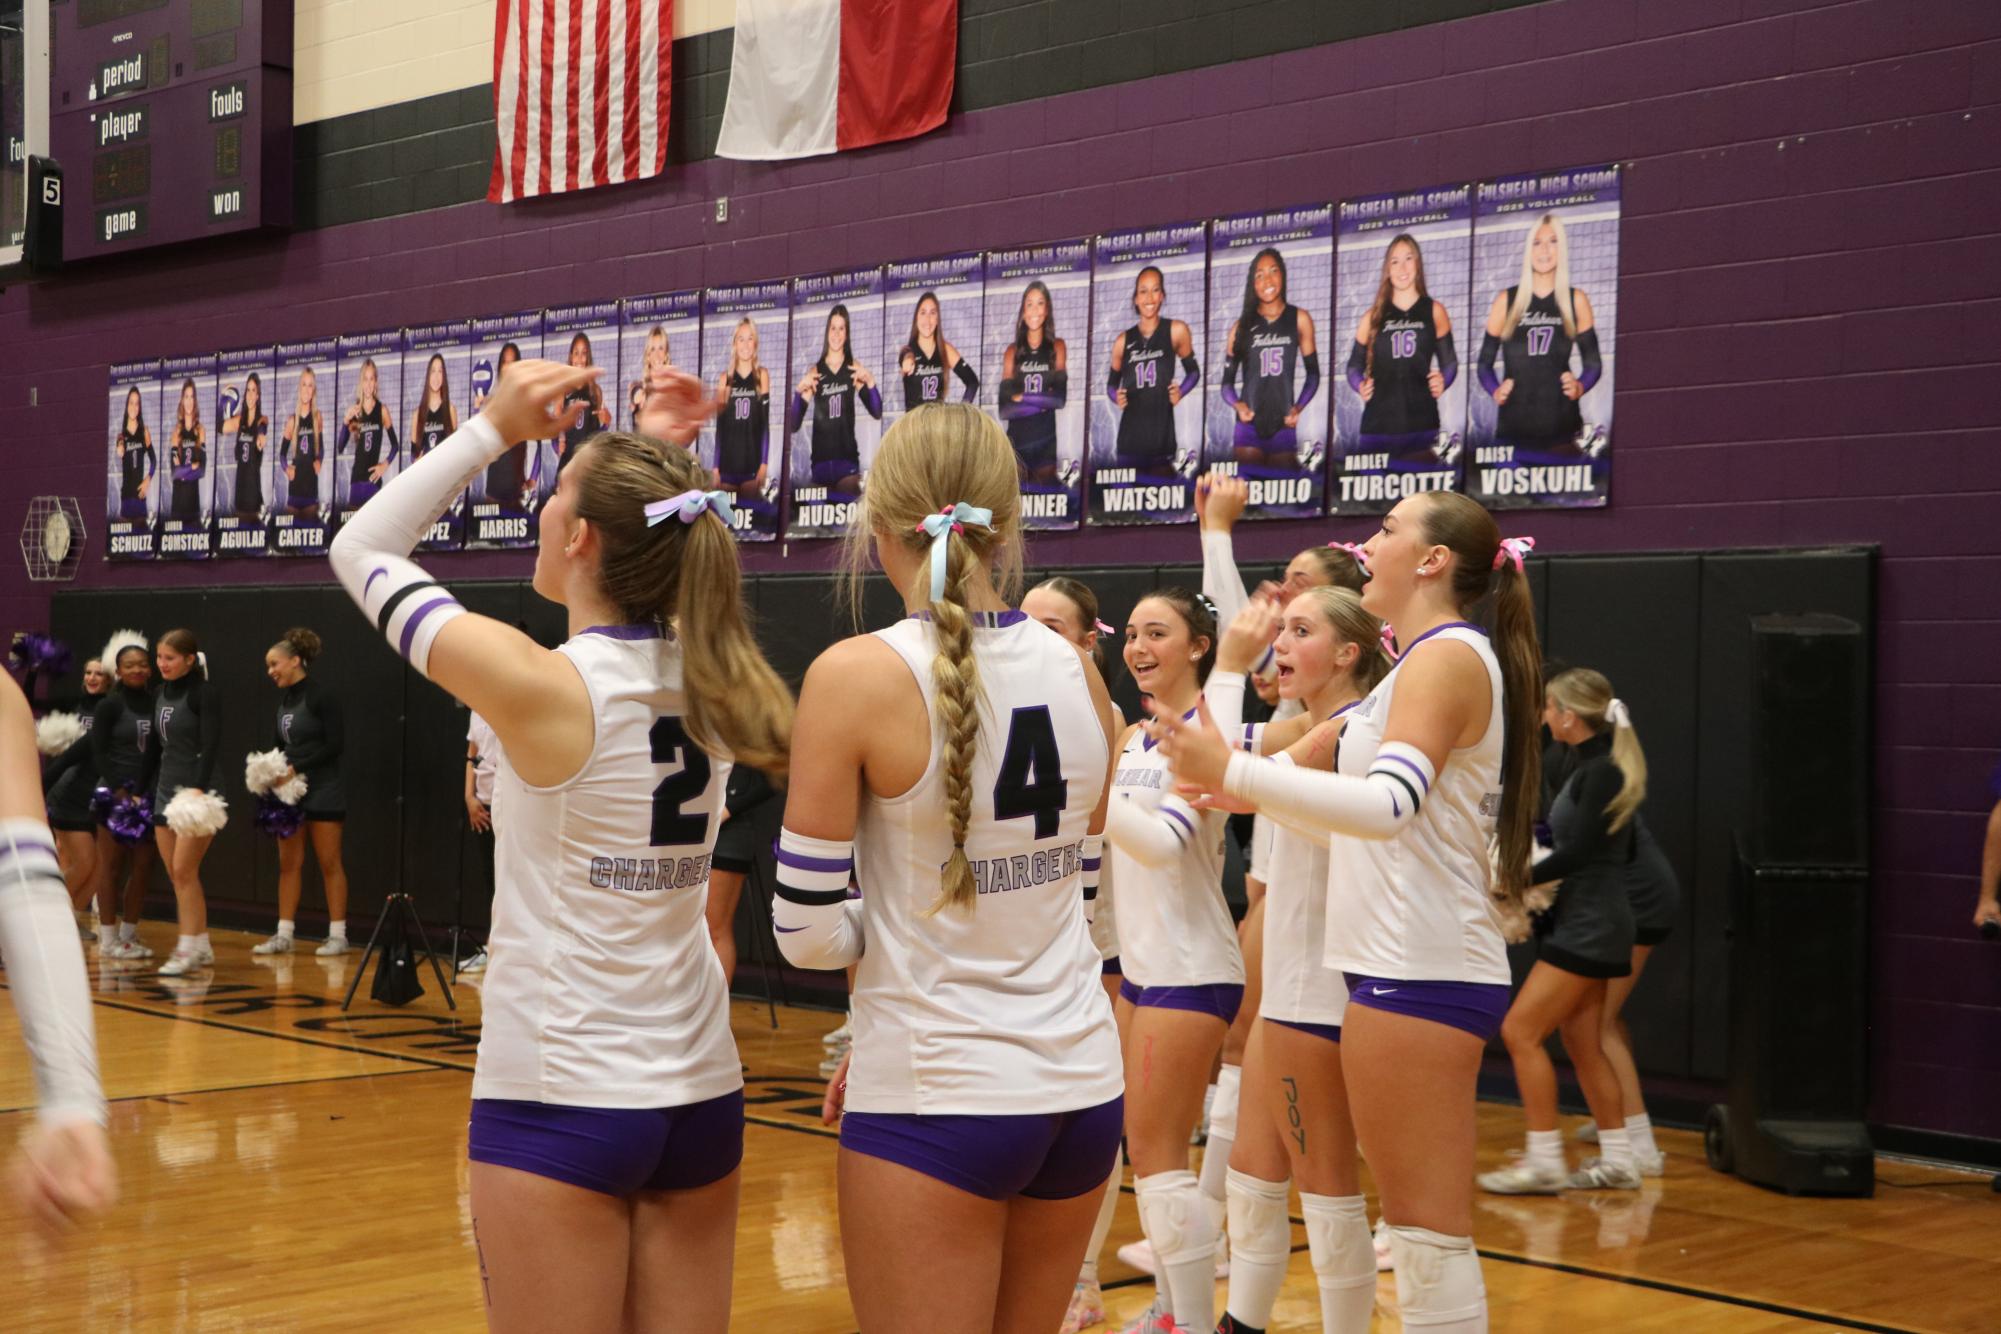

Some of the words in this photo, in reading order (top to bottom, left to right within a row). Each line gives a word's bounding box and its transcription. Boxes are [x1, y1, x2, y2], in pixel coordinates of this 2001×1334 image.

[103, 54, 142, 94] period
[211, 86, 243, 118] fouls
[101, 112, 141, 145] player
[45, 180, 58, 202] 5
[1478, 180, 1535, 202] FULSHEAR
[1538, 175, 1569, 195] HIGH
[1571, 168, 1619, 190] SCHOOL
[213, 191, 240, 215] won
[1527, 194, 1596, 210] VOLLEYBALL
[105, 210, 136, 240] game
[1387, 212, 1449, 227] VOLLEYBALL
[1390, 329, 1418, 359] 16
[1526, 325, 1556, 357] 17
[1135, 359, 1157, 389] 14
[1259, 346, 1284, 377] 15
[921, 375, 939, 400] 12
[735, 397, 750, 420] 10
[829, 393, 842, 419] 11
[300, 434, 309, 455] 4
[1475, 445, 1515, 464] DAISY
[1243, 477, 1312, 505] BUILO
[1338, 470, 1456, 502] TURCOTTE
[1480, 464, 1595, 496] VOSKUHL
[1019, 493, 1068, 518] NNER
[1103, 485, 1185, 512] WATSON
[111, 534, 153, 553] SCHULTZ
[161, 533, 210, 552] COMSTOCK
[219, 530, 266, 549] AGUILAR
[278, 528, 323, 547] CARTER
[478, 518, 527, 541] HARRIS
[160, 706, 174, 741] F
[281, 713, 294, 744] F
[648, 715, 711, 847] 2
[993, 704, 1068, 840] 4
[941, 839, 1084, 895] HARGERS
